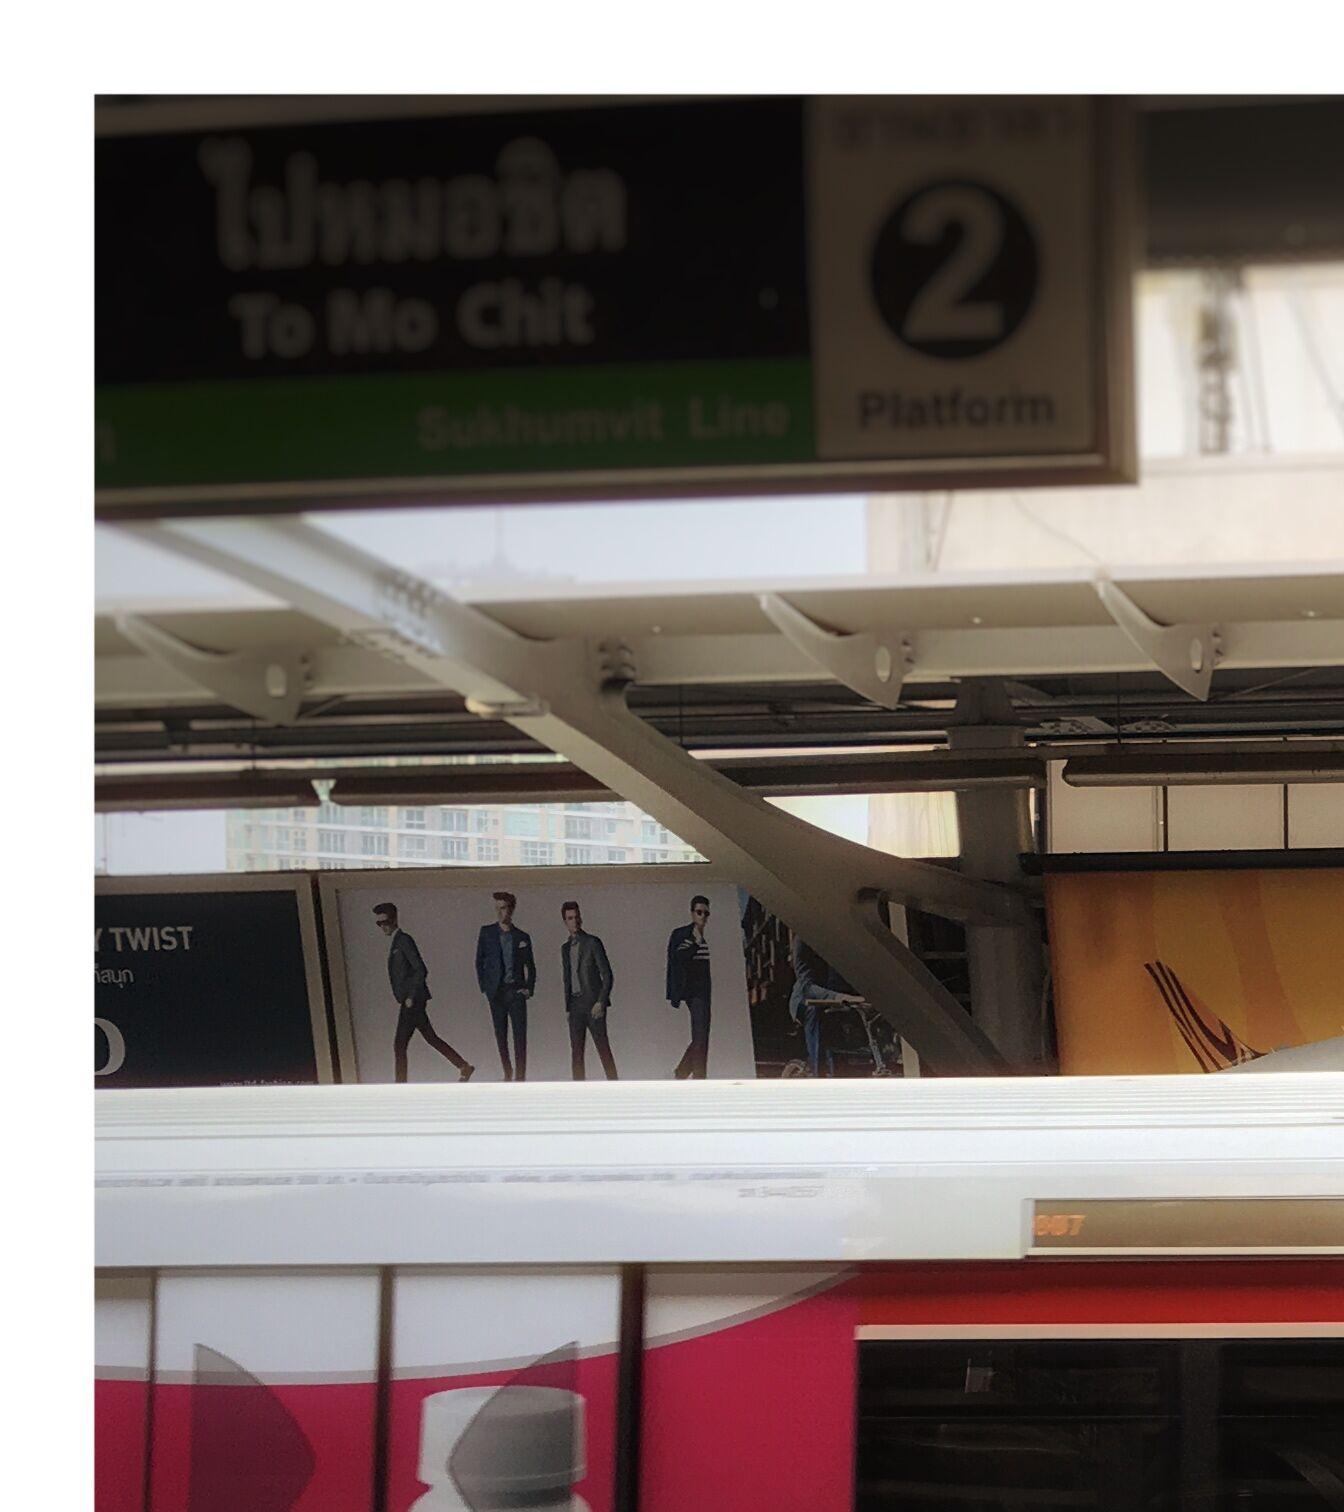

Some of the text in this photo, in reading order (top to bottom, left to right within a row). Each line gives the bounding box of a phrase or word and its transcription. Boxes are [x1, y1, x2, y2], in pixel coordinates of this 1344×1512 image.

[197, 134, 630, 271] ไปหมอชิต
[895, 185, 1005, 344] 2
[228, 277, 595, 360] To Mo Chit
[416, 391, 789, 453] Sukhumvit Line
[856, 387, 1057, 436] Platform
[109, 926, 193, 952] TWIST
